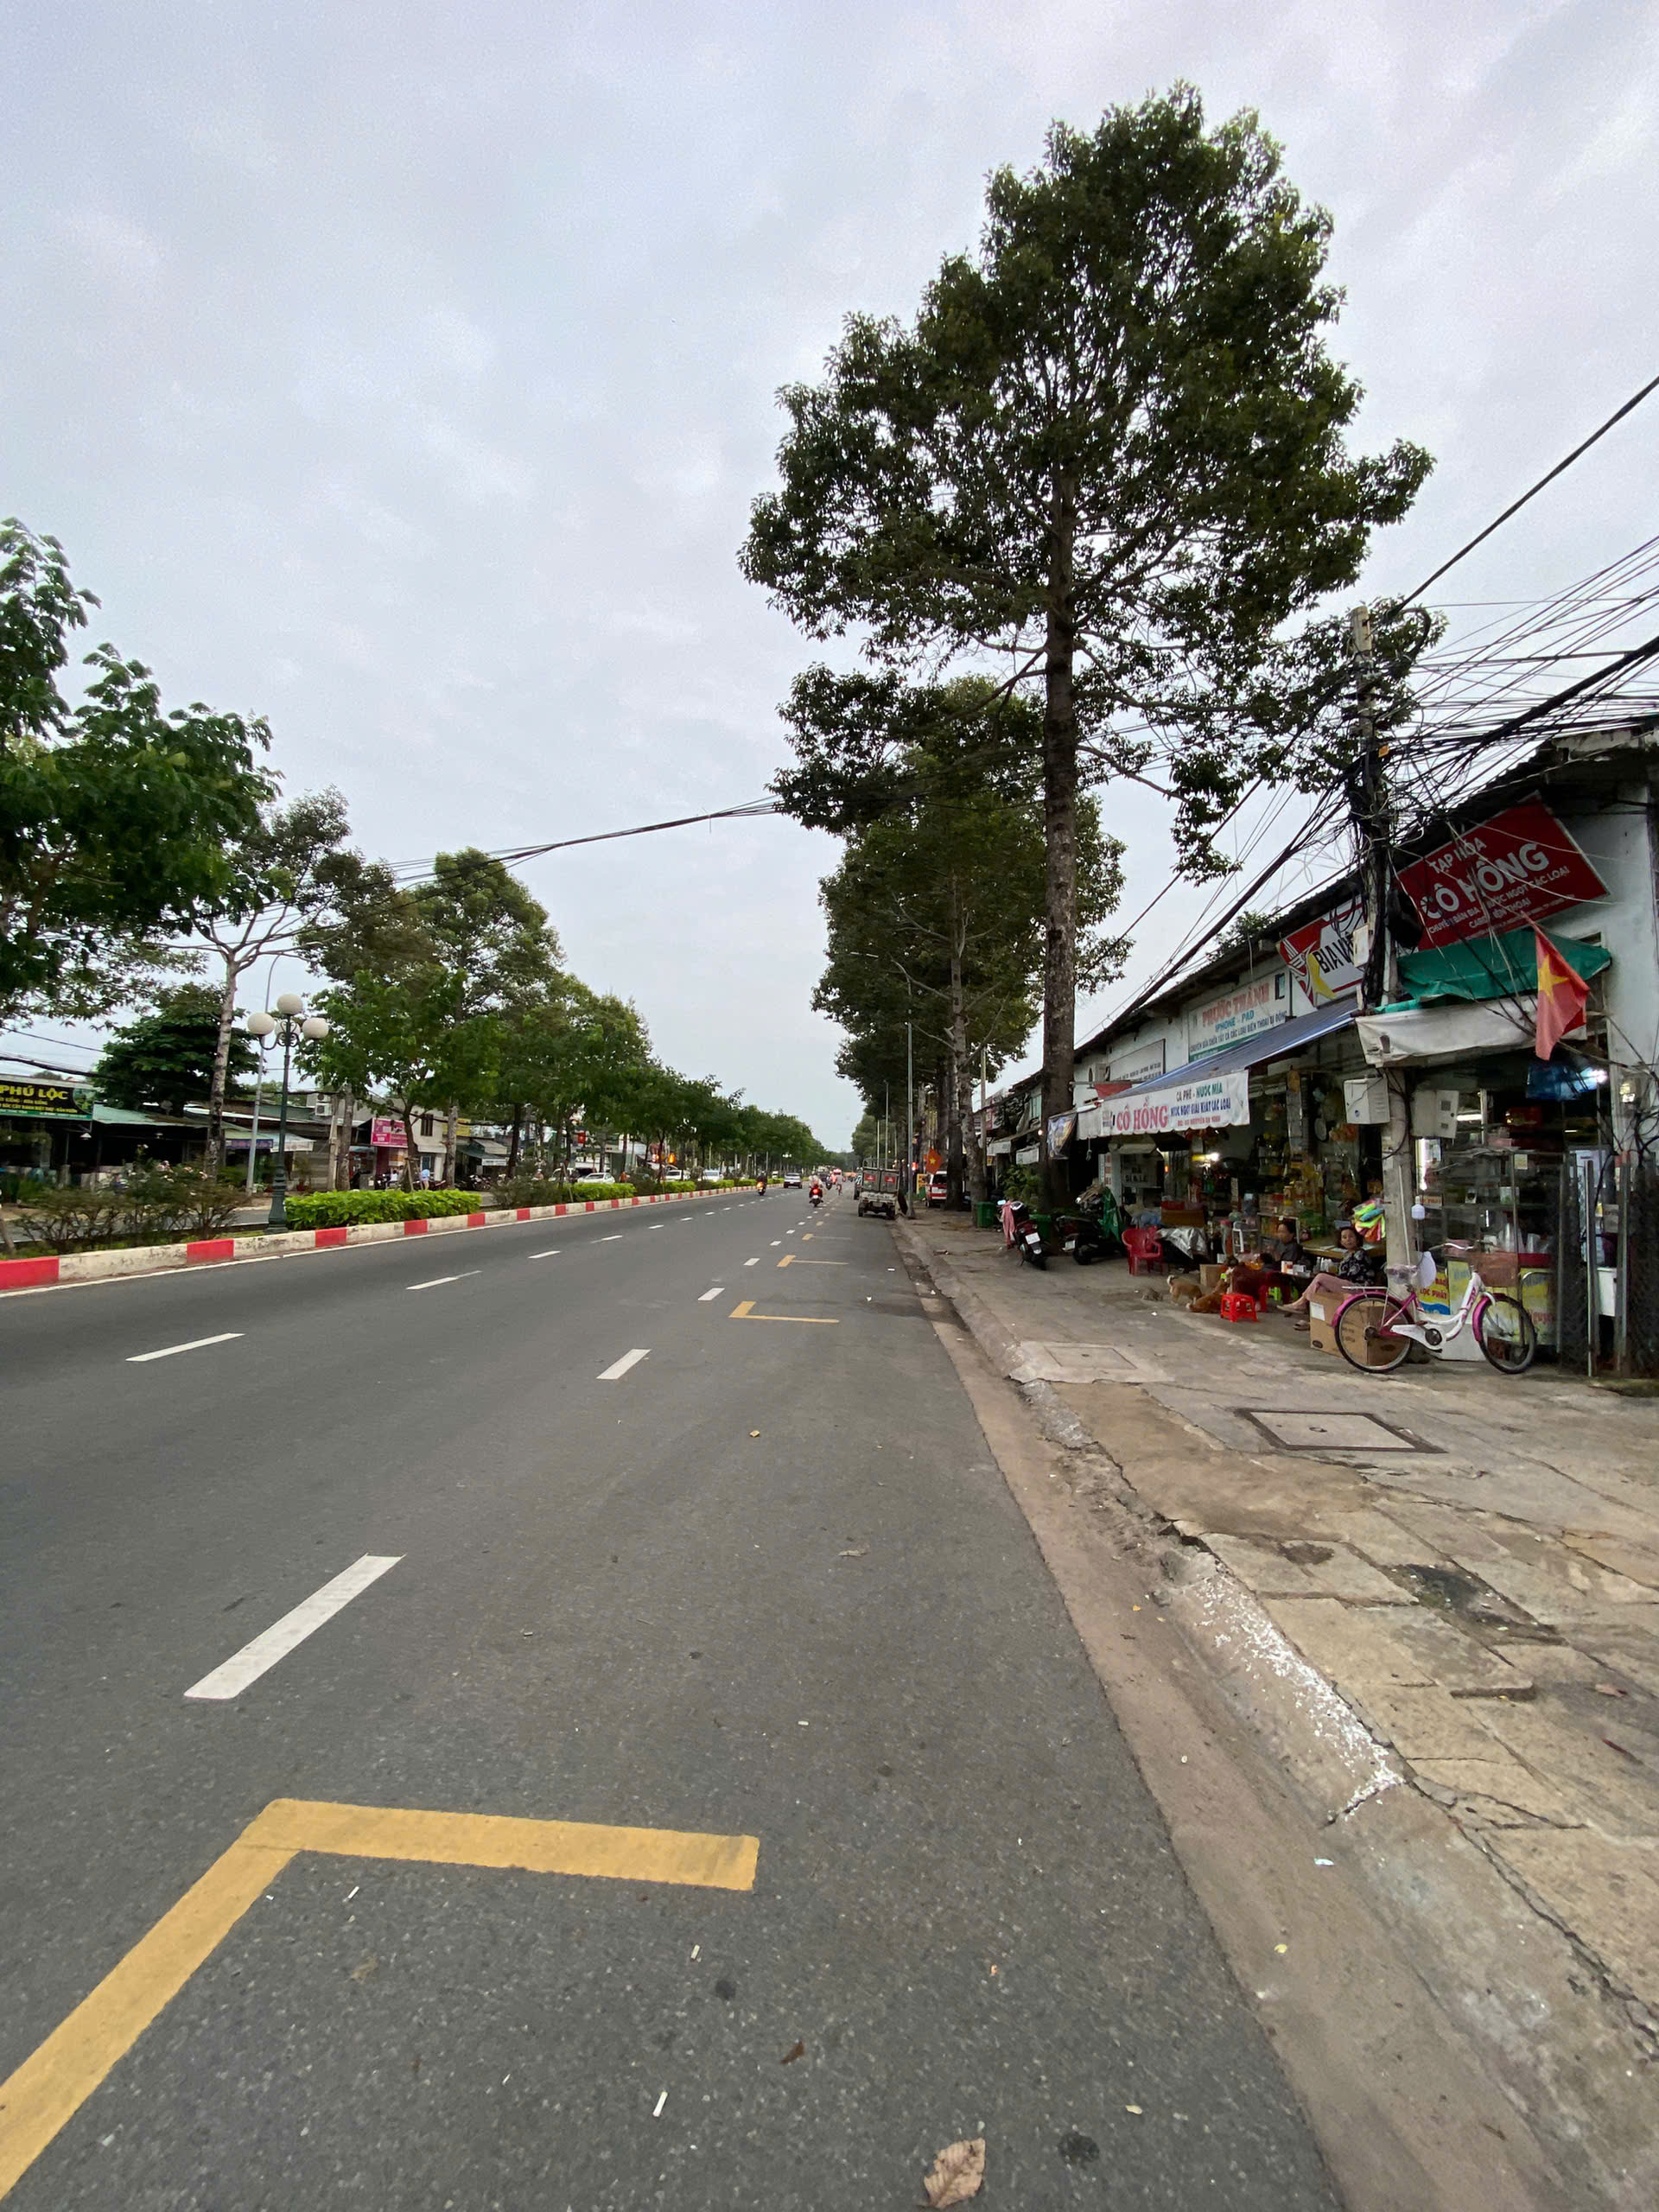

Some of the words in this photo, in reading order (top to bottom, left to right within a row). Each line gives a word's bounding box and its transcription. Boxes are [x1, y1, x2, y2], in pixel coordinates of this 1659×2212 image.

[1428, 852, 1455, 874] TẠP
[1420, 882, 1460, 919] CÔ
[1456, 843, 1549, 903] HỒNG
[1313, 945, 1344, 974] BIA
[0, 1084, 35, 1096] PHÚ
[38, 1088, 69, 1101] LỘC
[1116, 1105, 1132, 1132] CÔ
[1133, 1096, 1170, 1131] HỒNG
